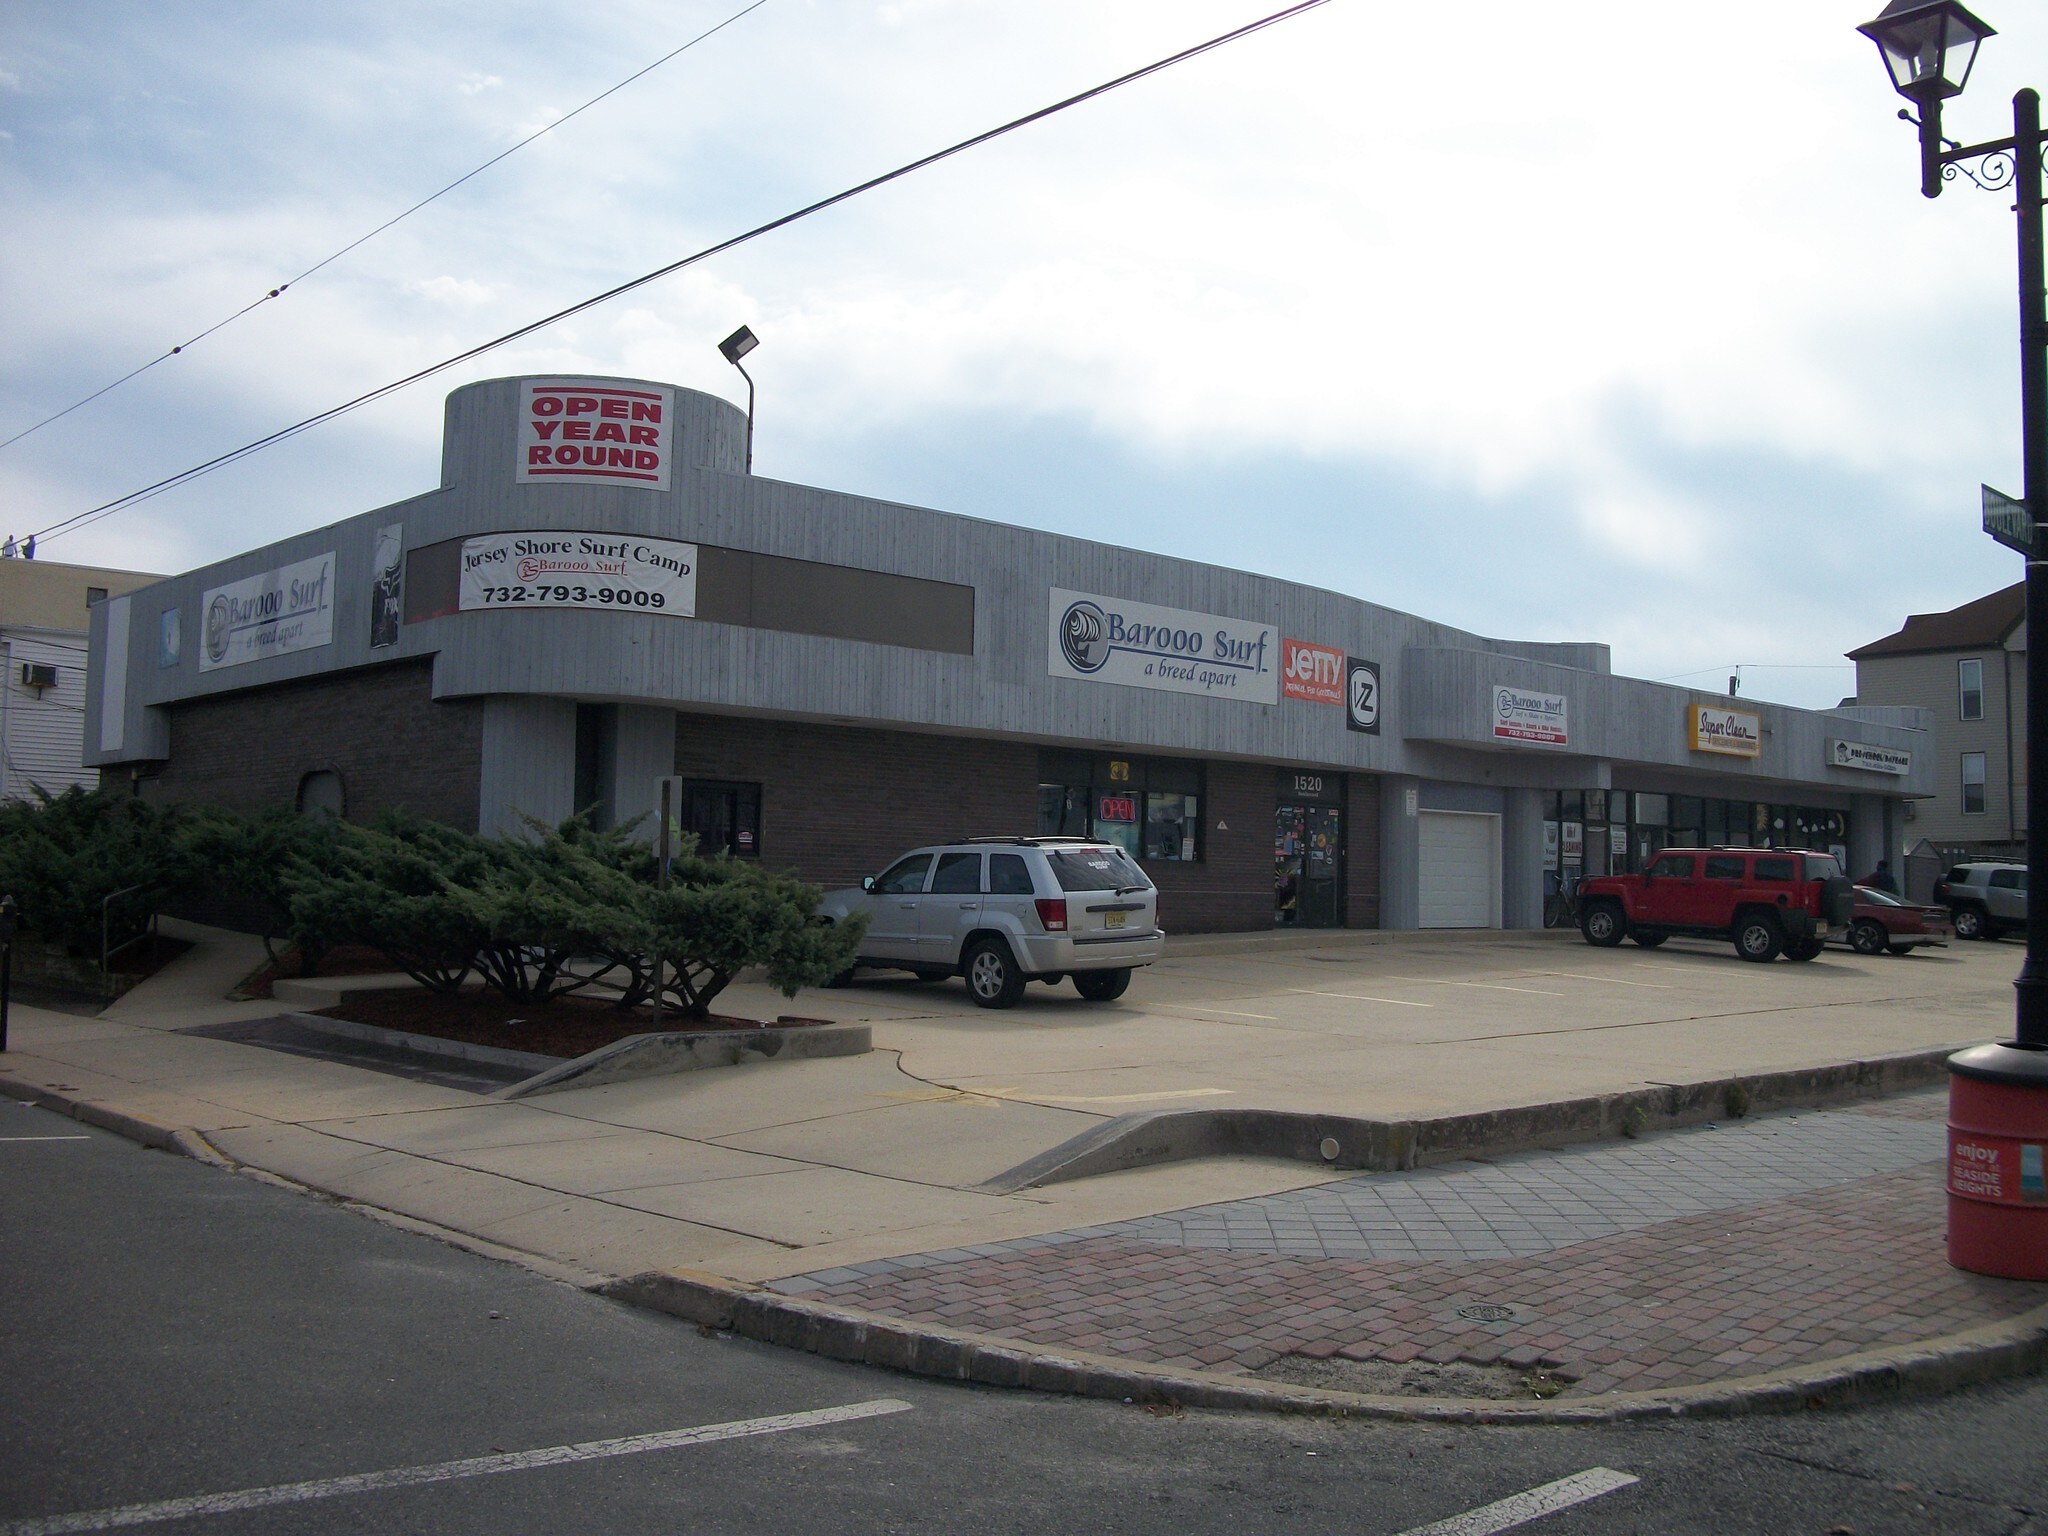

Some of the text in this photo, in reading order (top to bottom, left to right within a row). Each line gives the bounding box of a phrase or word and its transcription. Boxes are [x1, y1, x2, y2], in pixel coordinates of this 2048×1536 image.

[531, 396, 662, 423] OPEN
[531, 421, 660, 447] YEAR
[528, 445, 660, 471] ROUND
[464, 538, 691, 578] Jersey Shore Surf Camp
[539, 559, 628, 576] Barooo Surf
[230, 561, 329, 624] Barooo Surf
[482, 586, 666, 608] 732-793-9009
[1106, 613, 1269, 673] Barooo Surf
[1144, 659, 1238, 688] a breed apart
[1511, 694, 1563, 715] Barooo Surf
[1699, 711, 1724, 744] Super
[1725, 715, 1757, 740] Clean
[1294, 775, 1322, 792] 1520
[1102, 799, 1135, 821] OPEN
[1956, 1142, 1999, 1164] enjoy
[1953, 1165, 2000, 1184] SEASIDE
